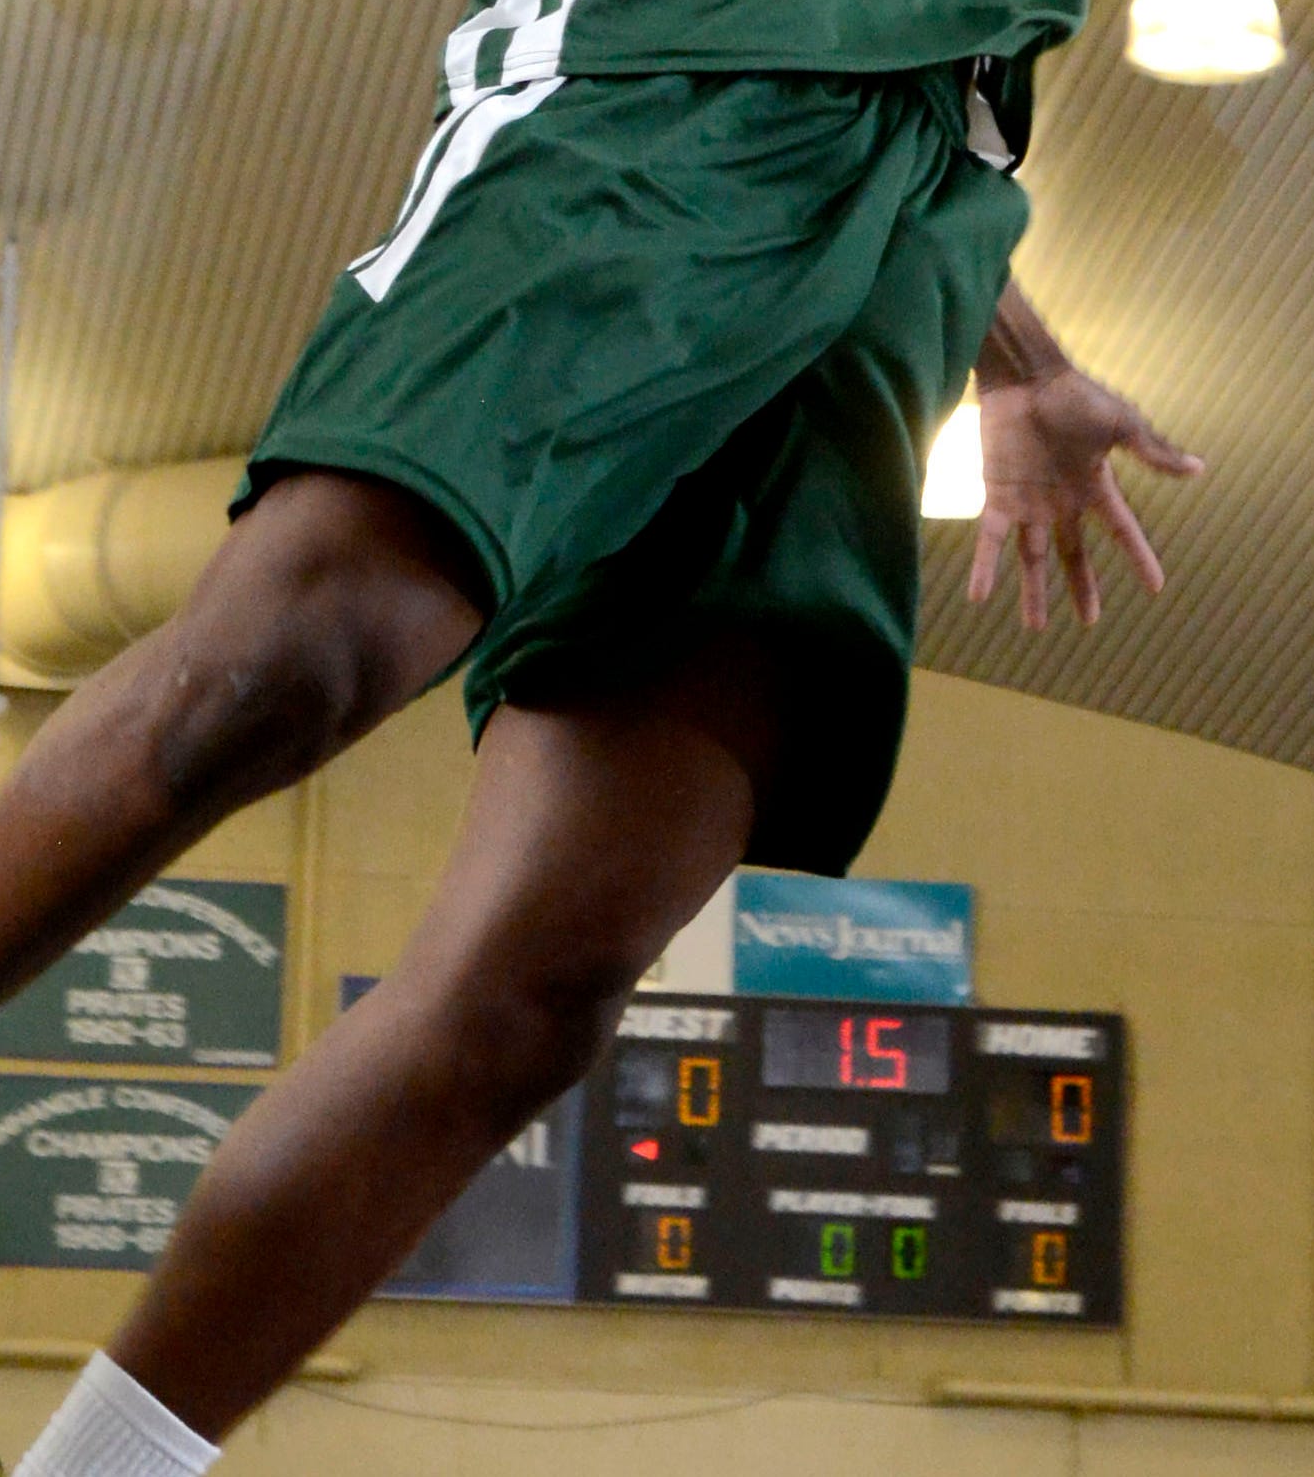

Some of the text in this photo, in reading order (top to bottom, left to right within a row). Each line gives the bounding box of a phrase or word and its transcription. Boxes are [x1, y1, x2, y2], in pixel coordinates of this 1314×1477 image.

[738, 911, 965, 961] News Journal
[66, 988, 186, 1020] PIRATES
[982, 1022, 1102, 1059] HOME
[677, 1056, 721, 1127] 0
[1050, 1074, 1093, 1144] 0
[27, 1128, 214, 1165] CHAMPIONS
[751, 1122, 871, 1156] PERIOD
[657, 1215, 691, 1270] 0
[820, 1222, 926, 1280] 0 0
[1032, 1230, 1067, 1285] 0
